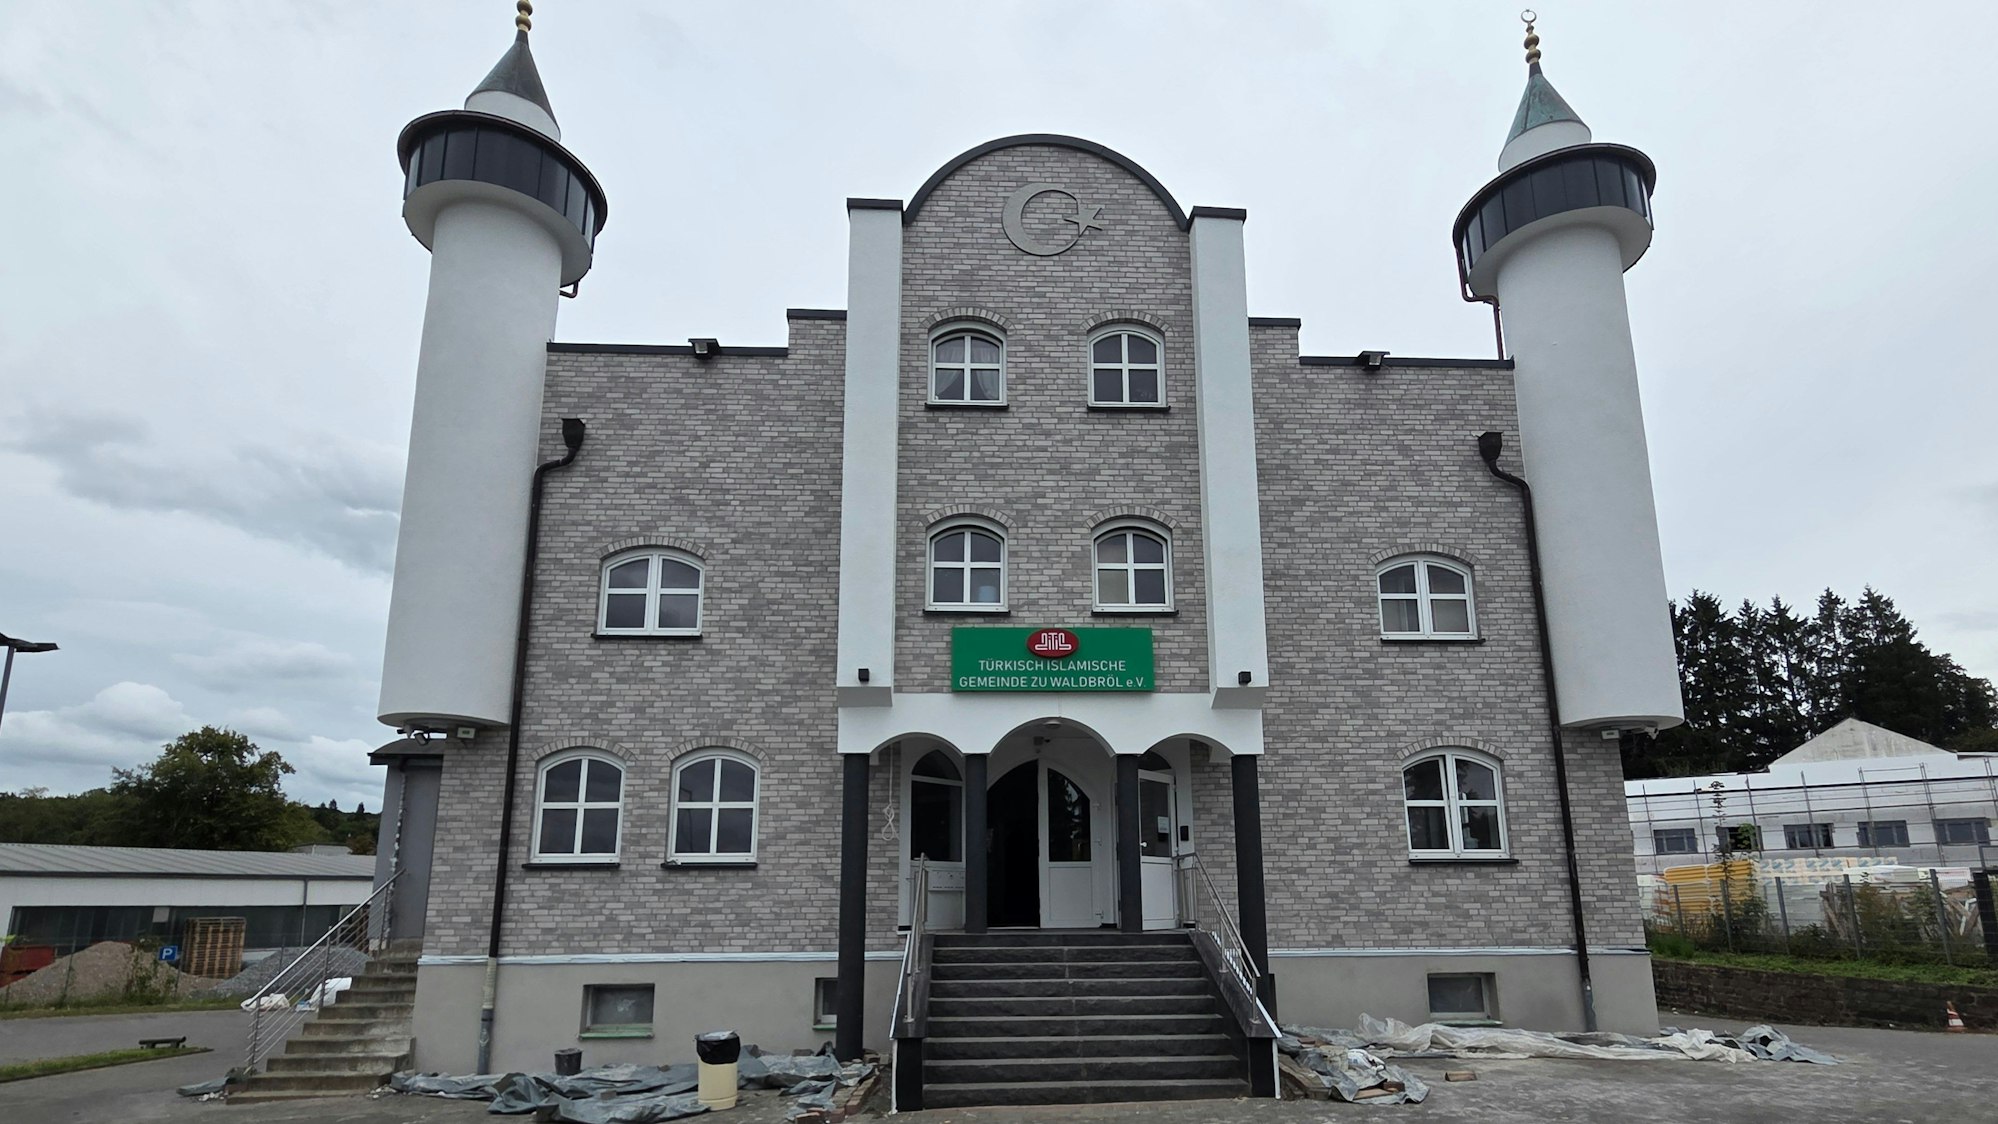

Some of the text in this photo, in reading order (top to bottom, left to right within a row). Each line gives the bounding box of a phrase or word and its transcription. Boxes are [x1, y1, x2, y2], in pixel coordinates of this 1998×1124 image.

[978, 658, 1126, 671] TÜRKISCH ISLAMISCHE
[959, 674, 1146, 688] GEMEINDE ZU WALDBRÖL e.V.
[162, 948, 173, 960] P
